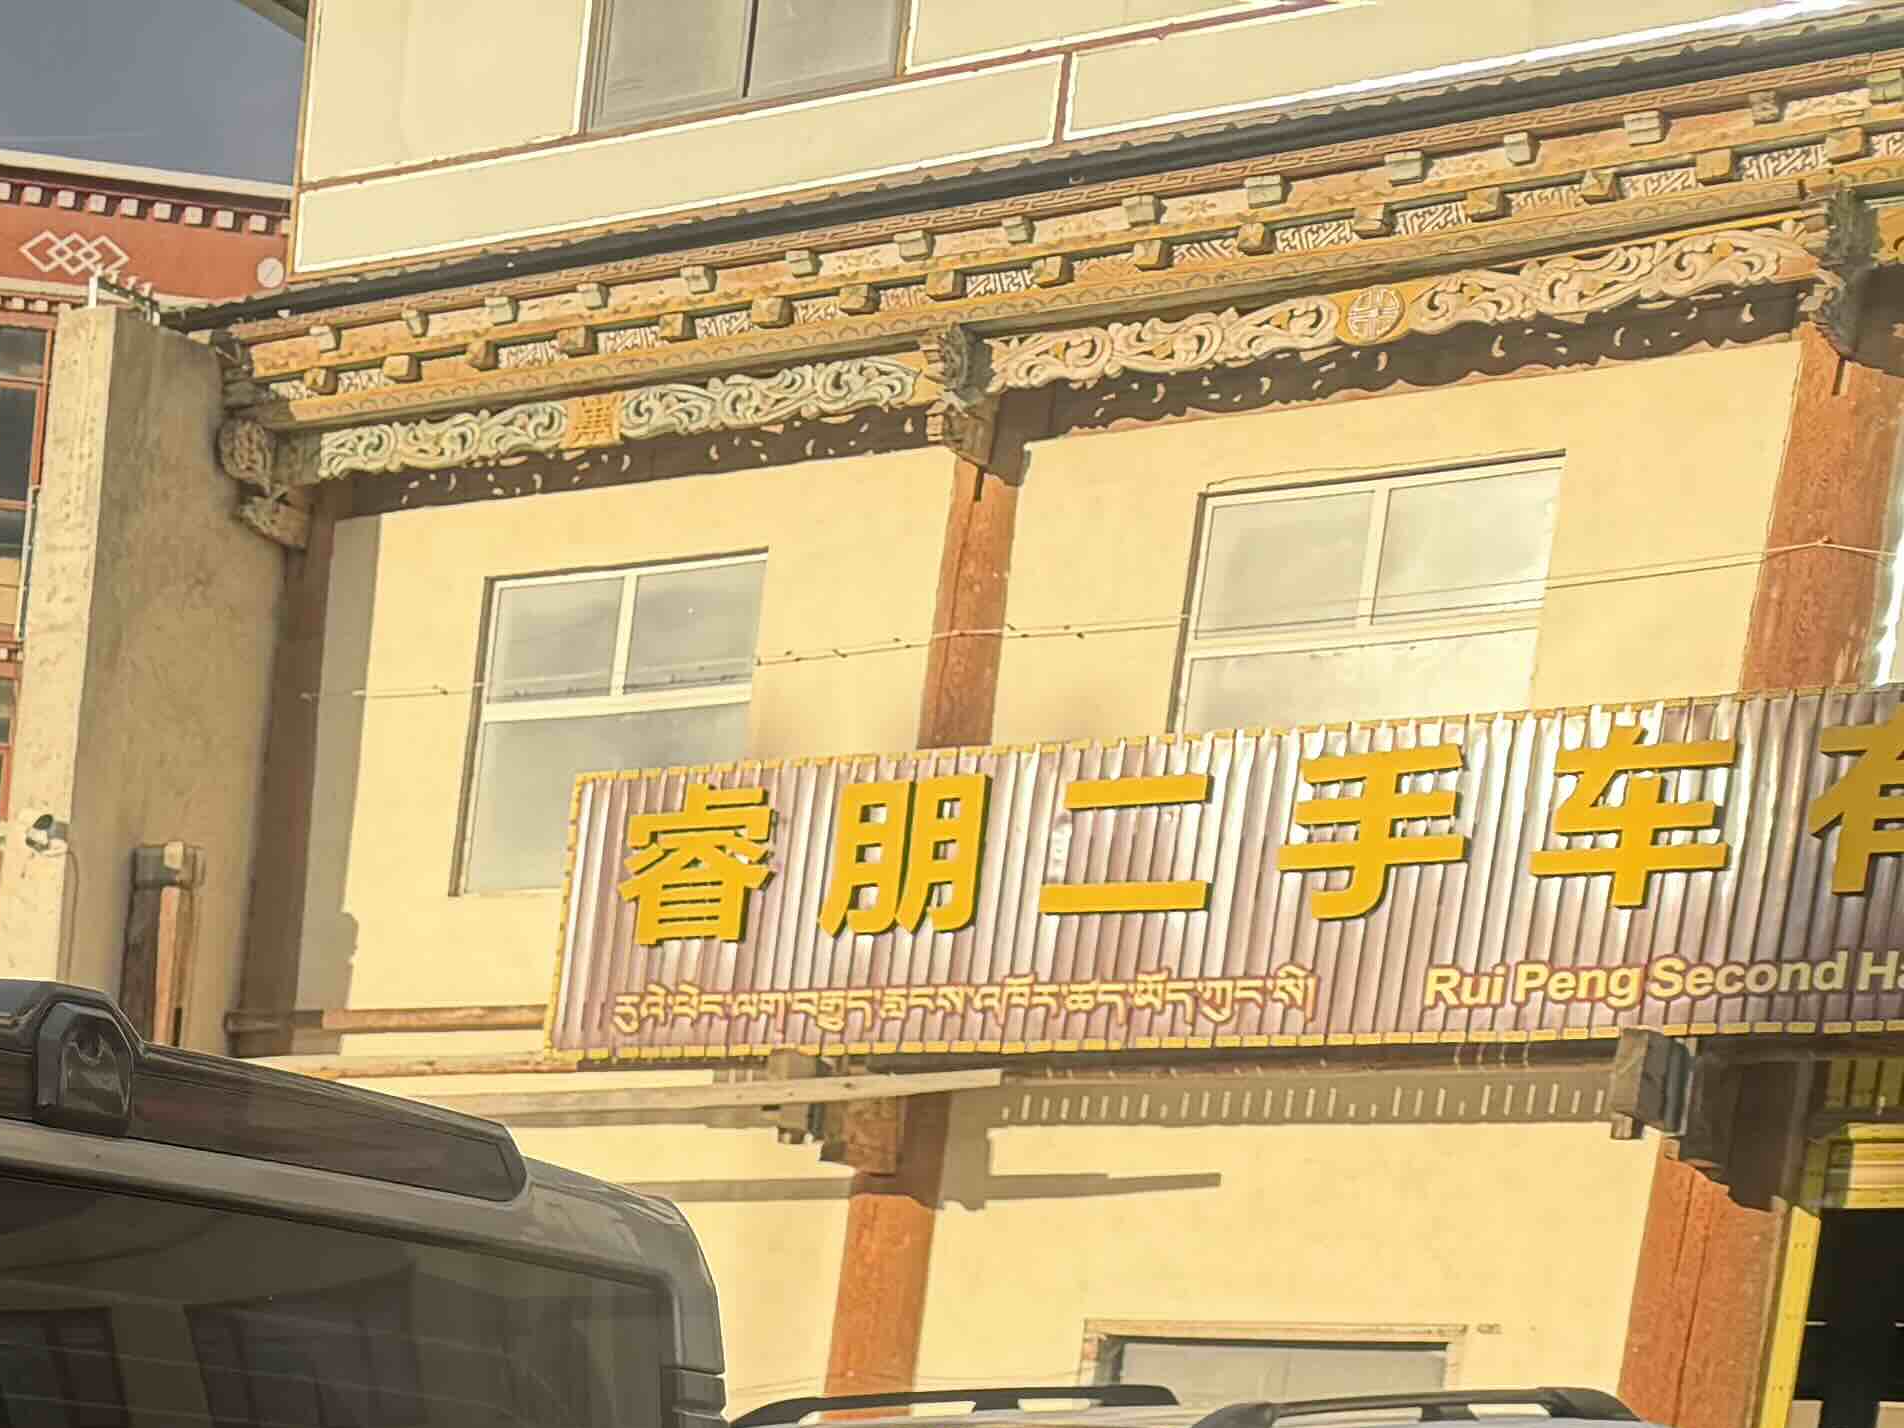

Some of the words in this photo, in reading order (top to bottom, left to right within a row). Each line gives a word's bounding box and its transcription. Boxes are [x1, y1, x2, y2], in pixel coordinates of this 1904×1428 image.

[1423, 966, 1506, 1007] Rui
[1512, 962, 1643, 1008] Peng
[1647, 951, 1849, 998] Second
[1857, 950, 1904, 992] H
